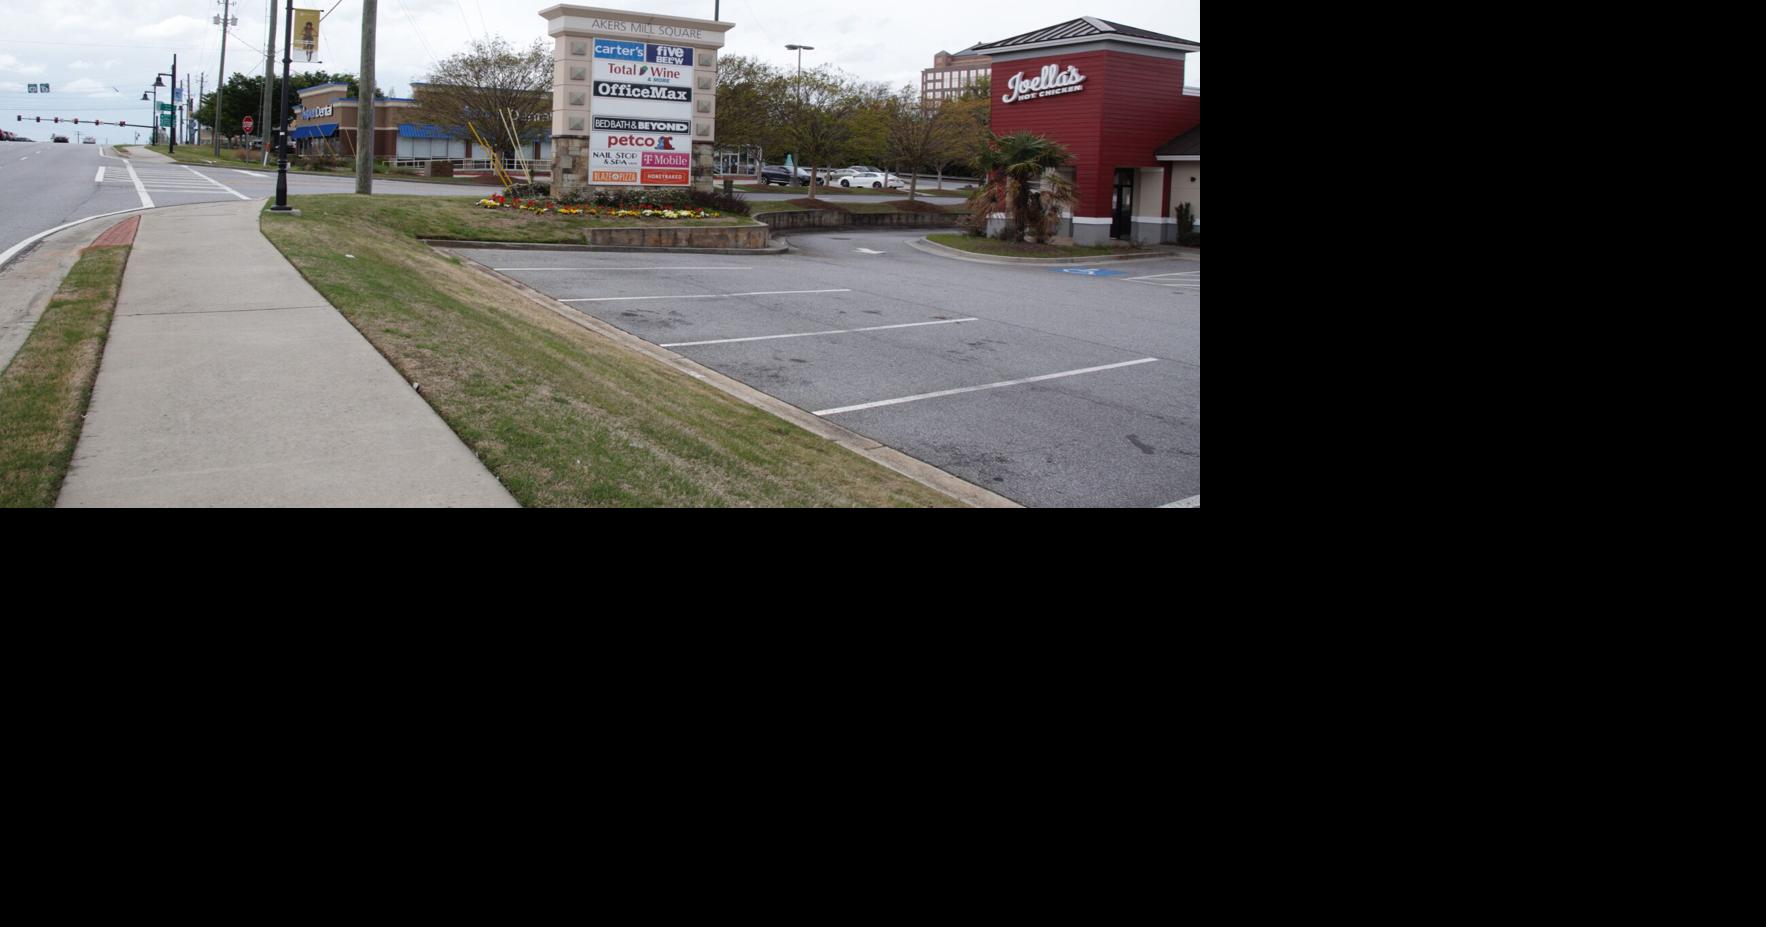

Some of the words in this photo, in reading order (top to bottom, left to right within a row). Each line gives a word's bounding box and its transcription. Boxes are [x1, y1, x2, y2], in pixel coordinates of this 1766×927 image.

[592, 19, 626, 31] AKERS
[631, 23, 653, 34] MILL
[658, 26, 702, 39] SQUARE
[595, 45, 644, 57] carter's
[657, 46, 684, 57] five
[608, 63, 636, 75] Total
[651, 67, 680, 79] Wine
[1002, 64, 1087, 103] Joella's
[598, 83, 687, 100] OfficeMax
[1018, 93, 1037, 101] HOT
[1039, 85, 1083, 97] CHICKEN
[595, 119, 611, 128] BED
[611, 120, 630, 128] BATH
[631, 121, 638, 129] &
[638, 121, 688, 131] BEYOND
[608, 134, 655, 148] petco
[655, 155, 687, 165] Mobile
